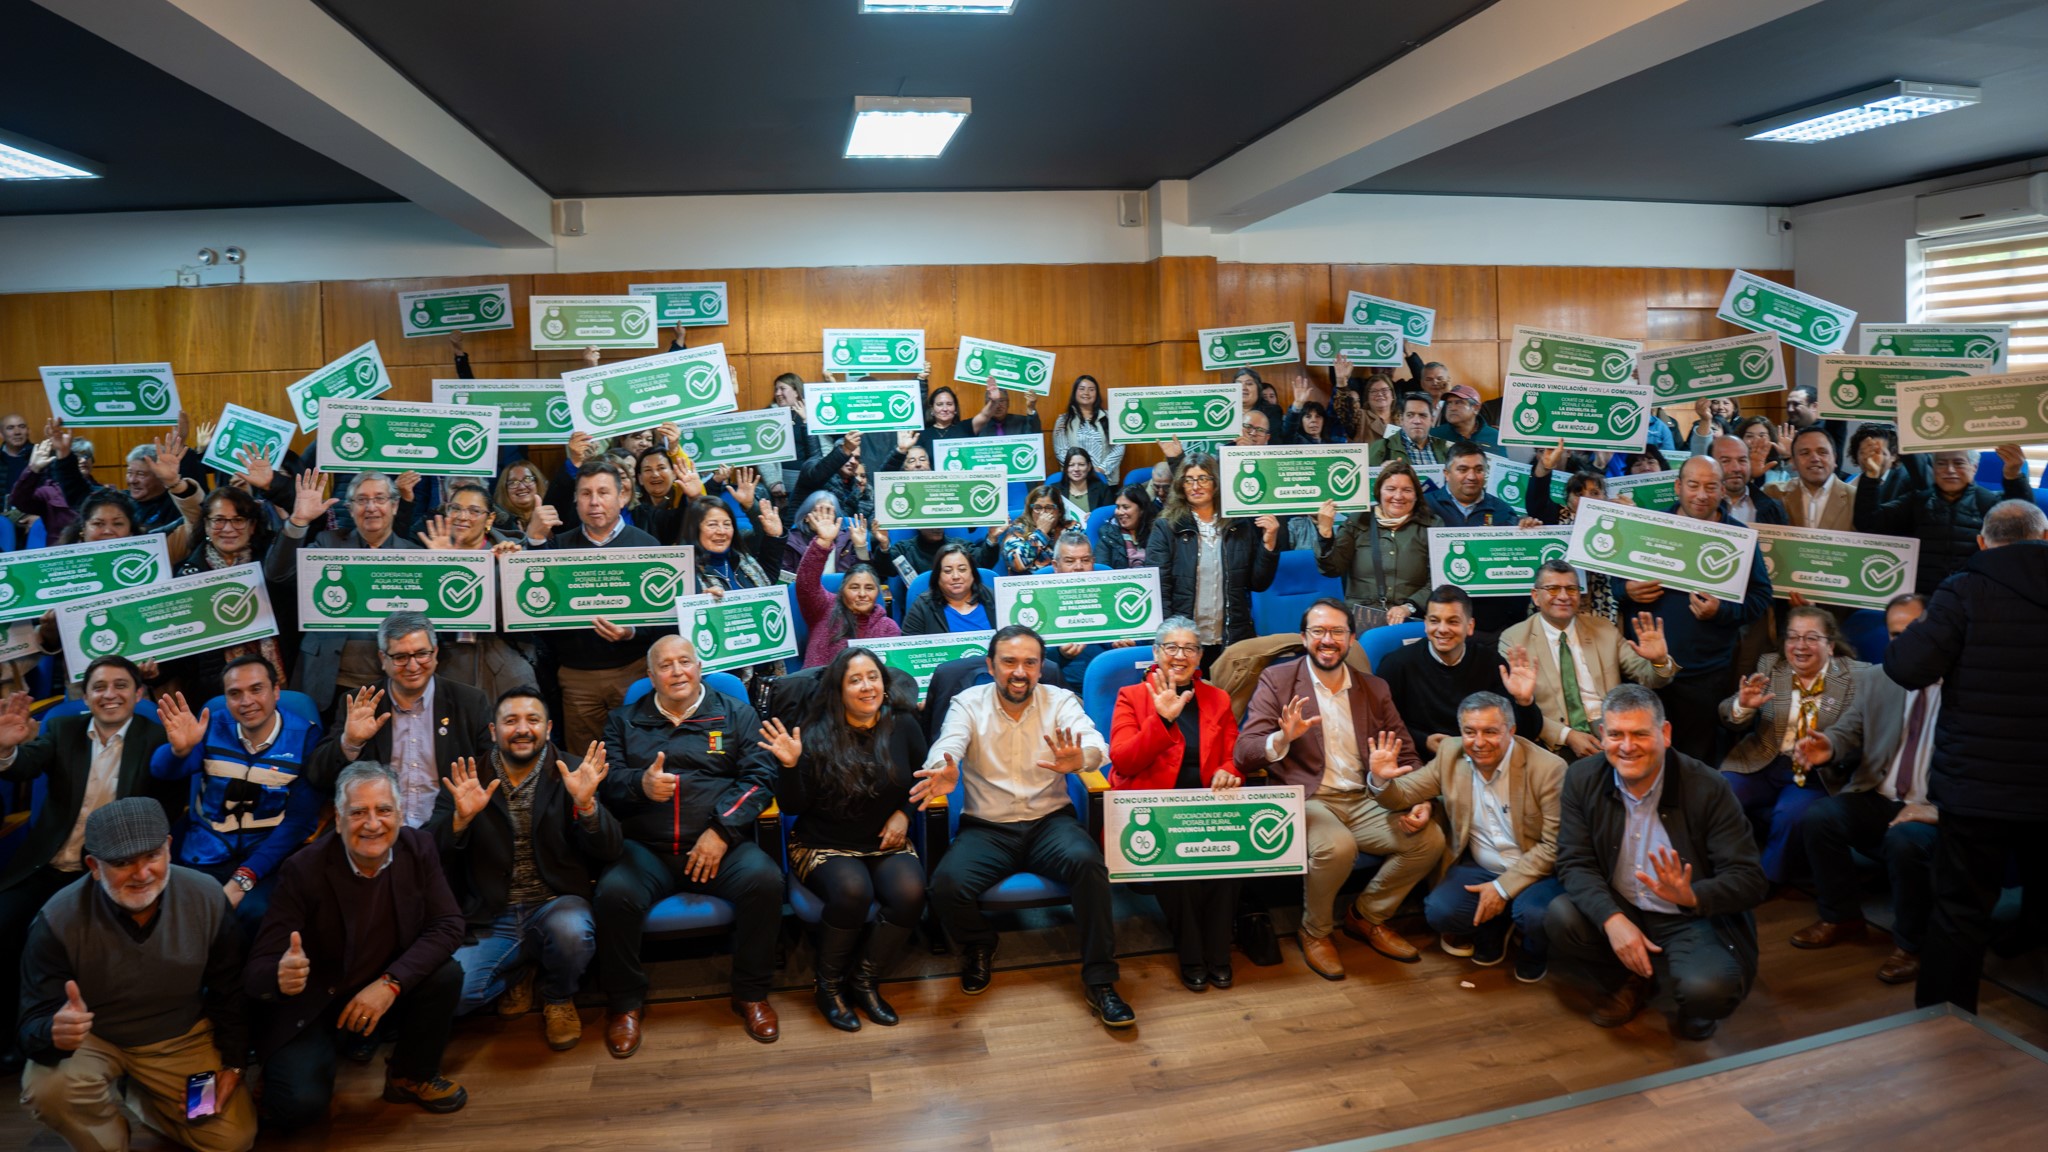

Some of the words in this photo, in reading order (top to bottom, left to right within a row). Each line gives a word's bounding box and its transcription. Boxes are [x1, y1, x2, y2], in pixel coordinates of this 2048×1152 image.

[570, 371, 607, 382] CONCURSO
[609, 361, 653, 375] VINCULACIÓN
[678, 349, 718, 361] COMUNIDAD
[1547, 383, 1587, 392] VINCULACIÓN
[1905, 384, 1945, 392] CONCURSO
[1949, 378, 2001, 389] VINCULACIÓN
[371, 405, 420, 413] VINCULACIÓN
[643, 399, 668, 409] YUNGAY
[1586, 504, 1624, 515] CONCURSO
[1626, 511, 1674, 525] VINCULACIÓN
[1703, 526, 1749, 539] COMUNIDAD
[1783, 531, 1832, 541] VINCULACIÓN
[1863, 539, 1911, 549] COMUNIDAD
[18, 549, 75, 560] VINCULACIÓN
[108, 539, 157, 549] COMUNIDAD
[554, 554, 606, 562] VINCULACIÓN
[1639, 555, 1676, 567] TREHUACO
[1041, 577, 1085, 585] VINCULACIÓN
[1815, 576, 1842, 584] CARLOS
[48, 585, 91, 595] COIHUECO
[65, 598, 113, 613] CONCURSO
[115, 585, 172, 603] VINCULACIÓN
[204, 569, 253, 584] COMUNIDAD
[1068, 617, 1095, 625] RÁNQUIL
[152, 626, 195, 640] COIHUECO
[892, 639, 932, 647] VINCULACIÓN
[1113, 797, 1157, 805] CONCURSO
[1161, 794, 1215, 803] VINCULACIÓN
[1247, 792, 1296, 800] COMUNIDAD
[1173, 812, 1212, 820] ASOCIACIÓN
[1248, 809, 1285, 823] ADJUDICADO
[1184, 846, 1199, 854] SAN
[1202, 845, 1231, 853] CARLOS
